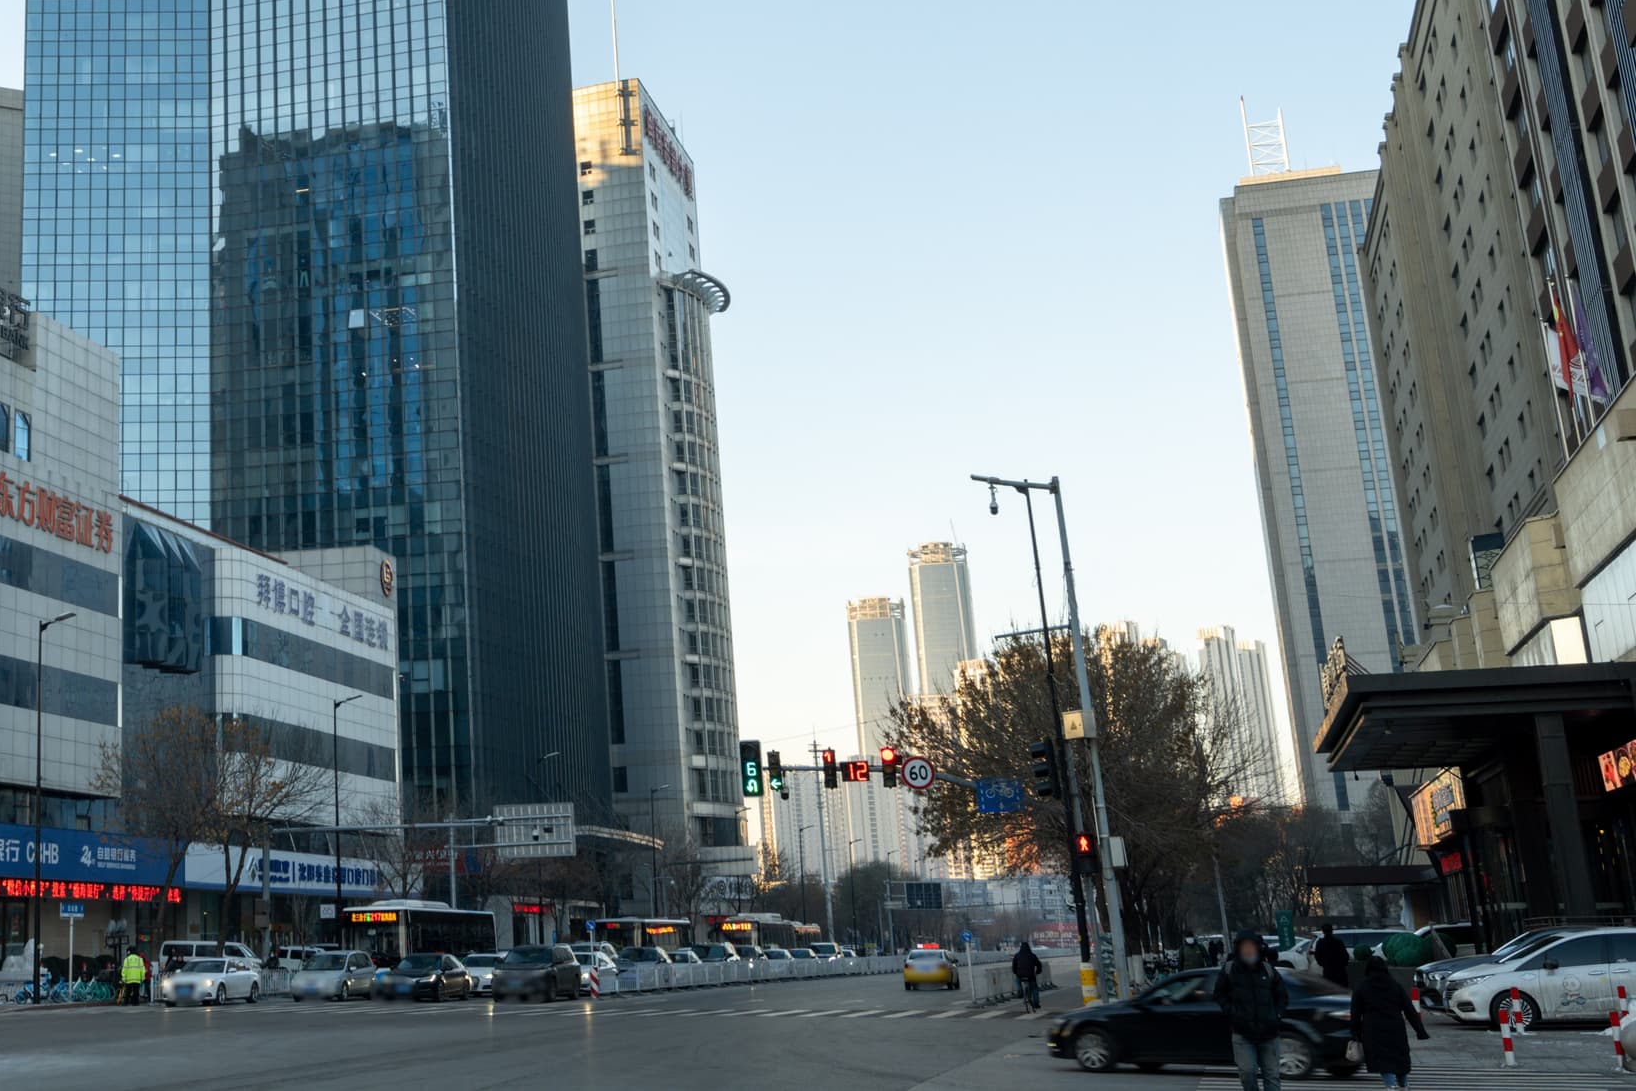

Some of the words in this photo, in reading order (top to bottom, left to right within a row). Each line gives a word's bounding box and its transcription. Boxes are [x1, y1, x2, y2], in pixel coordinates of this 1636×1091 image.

[257, 574, 315, 626] 拜博口腔
[337, 605, 388, 651] 全国连锁
[848, 762, 868, 781] 12
[909, 765, 928, 781] 60
